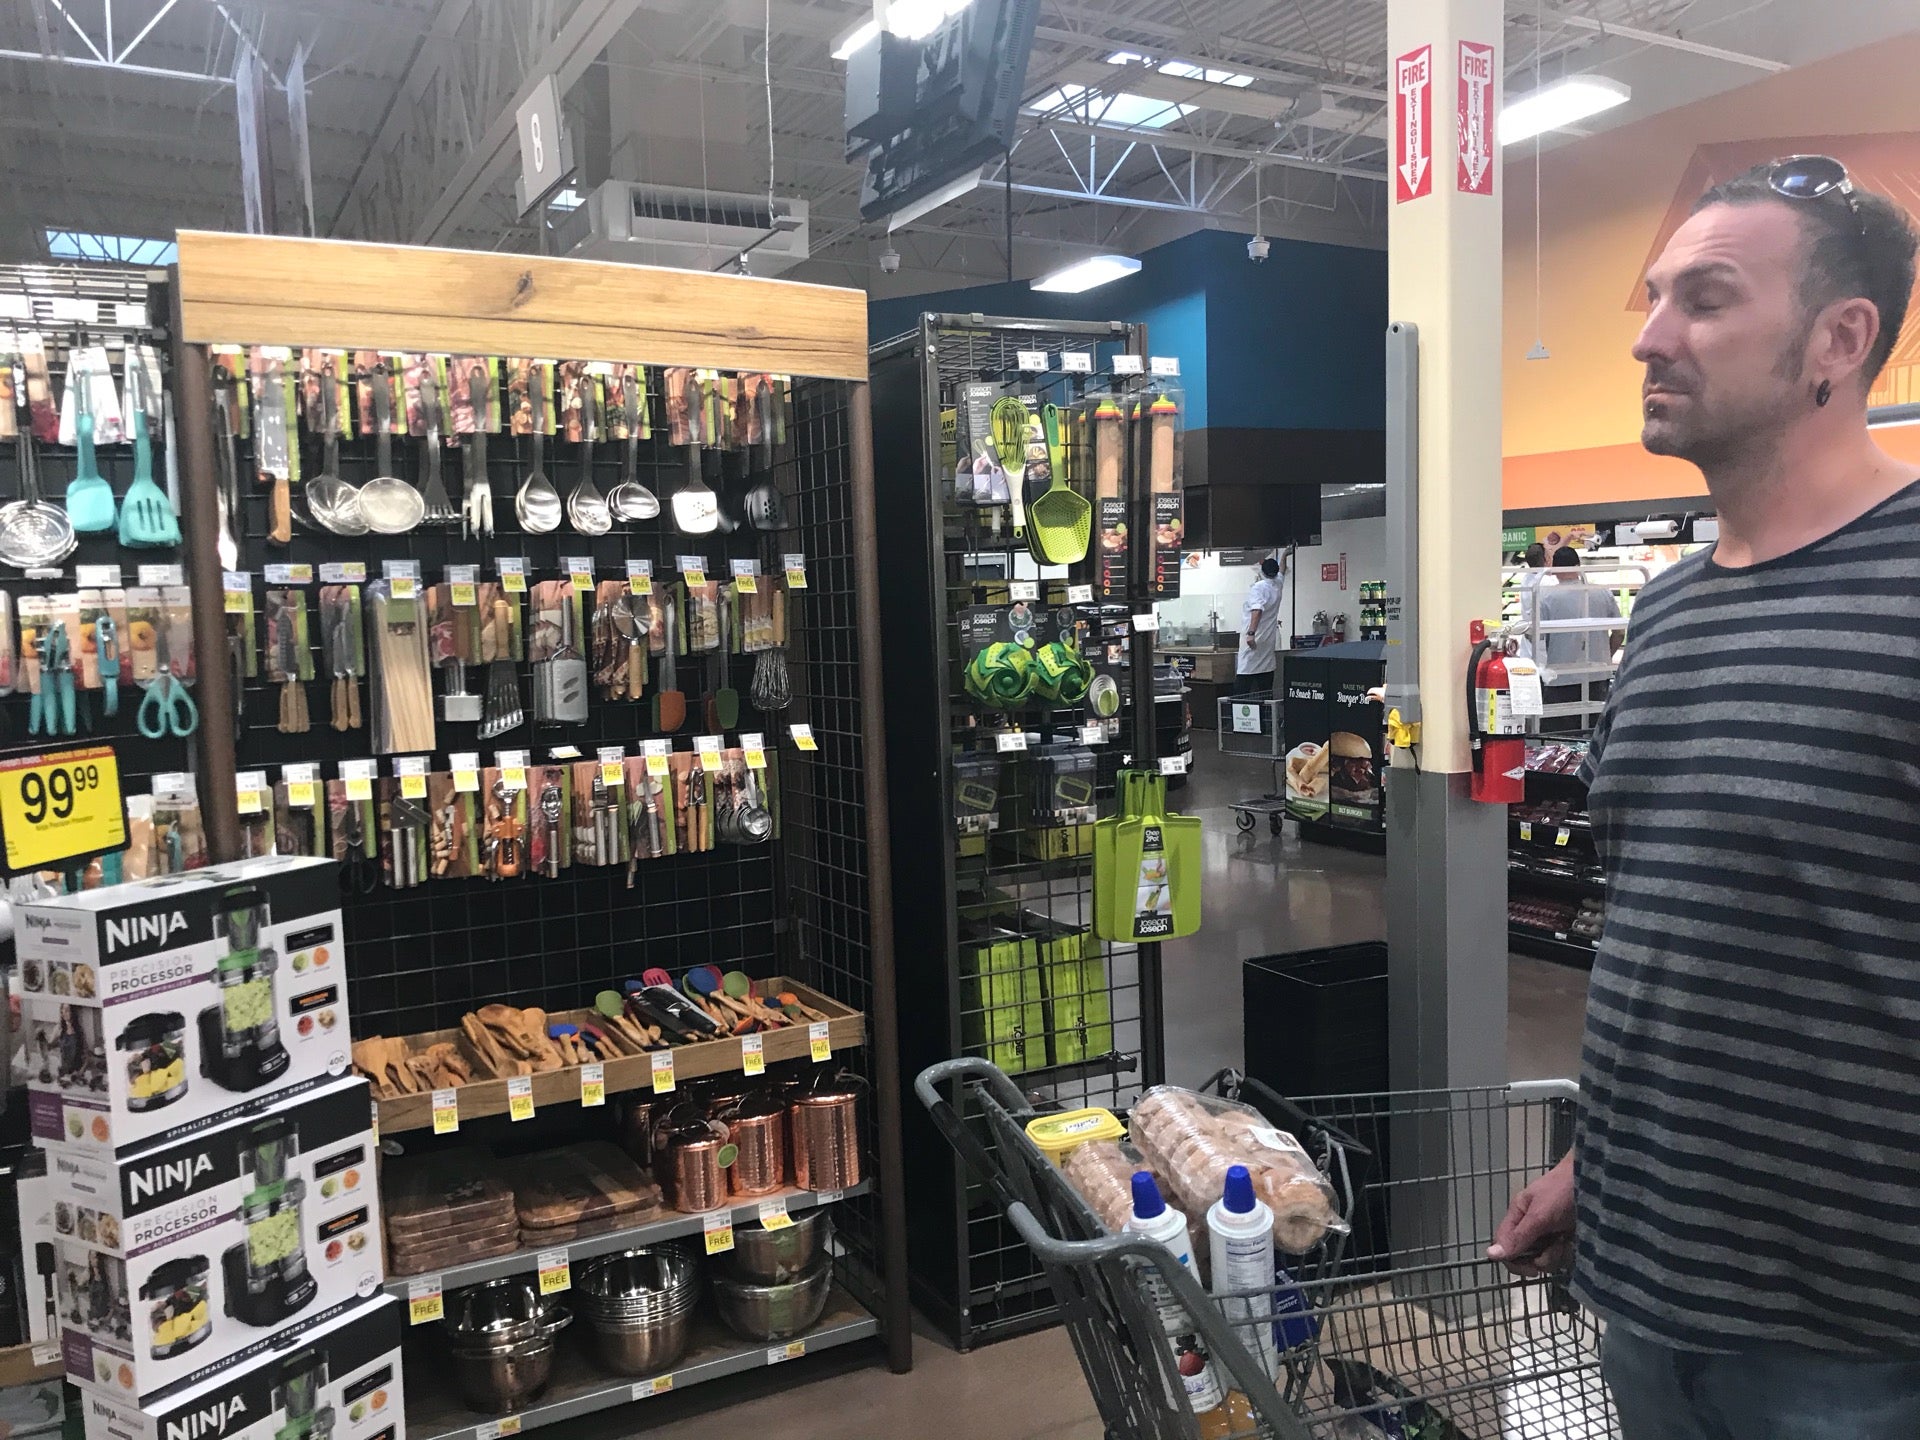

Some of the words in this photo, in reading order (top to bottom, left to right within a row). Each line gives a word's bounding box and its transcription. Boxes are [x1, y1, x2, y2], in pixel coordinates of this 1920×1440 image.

[1402, 61, 1426, 88] FIRE
[1464, 56, 1488, 78] FIRE
[531, 113, 544, 173] 8
[1289, 688, 1295, 698] To
[1311, 690, 1325, 700] Time
[1337, 692, 1358, 707] Burger
[21, 768, 74, 824] 99
[105, 911, 188, 953] NINJA
[1140, 925, 1167, 933] Joseph
[110, 954, 192, 980] PRECISION
[112, 964, 193, 993] PROCESSOR
[329, 1056, 345, 1066] 400
[130, 1153, 214, 1205] NINJA
[135, 1205, 218, 1243] PROCESSOR
[709, 1236, 730, 1246] FREE
[359, 1276, 375, 1288] 400
[543, 1275, 566, 1286] FREE
[414, 1306, 439, 1316] FREE
[190, 1356, 236, 1381] SPIRALIZE
[166, 1394, 247, 1440] NINJA
